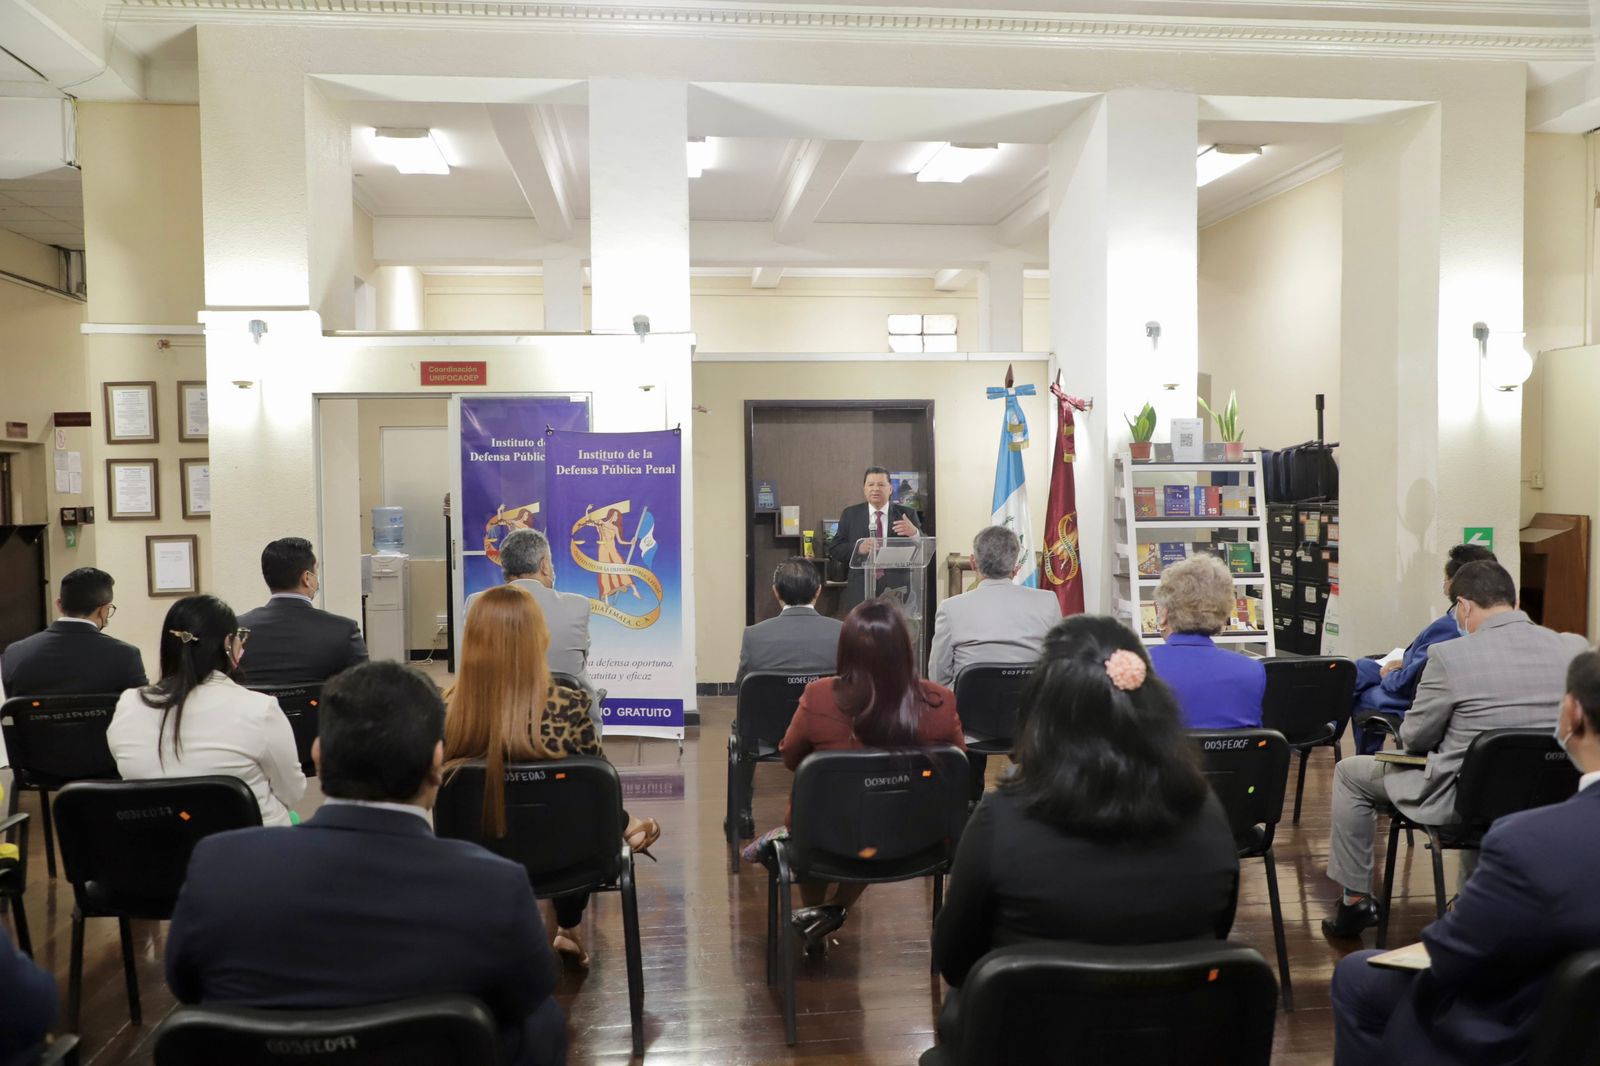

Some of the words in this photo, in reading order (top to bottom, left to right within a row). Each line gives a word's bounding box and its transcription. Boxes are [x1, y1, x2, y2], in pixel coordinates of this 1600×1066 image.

[491, 438, 535, 447] Instituto
[537, 438, 545, 447] d
[470, 452, 510, 461] Defensa
[513, 451, 546, 461] Públic
[578, 449, 625, 460] Instituto
[627, 450, 640, 459] de
[643, 449, 653, 459] la
[556, 464, 599, 475] Defensa
[602, 463, 642, 474] Pública
[645, 464, 676, 474] Penal
[596, 658, 629, 669] defensa
[632, 660, 674, 669] oportuna,
[626, 672, 652, 681] eficaz
[617, 707, 672, 718] GRATUITO
